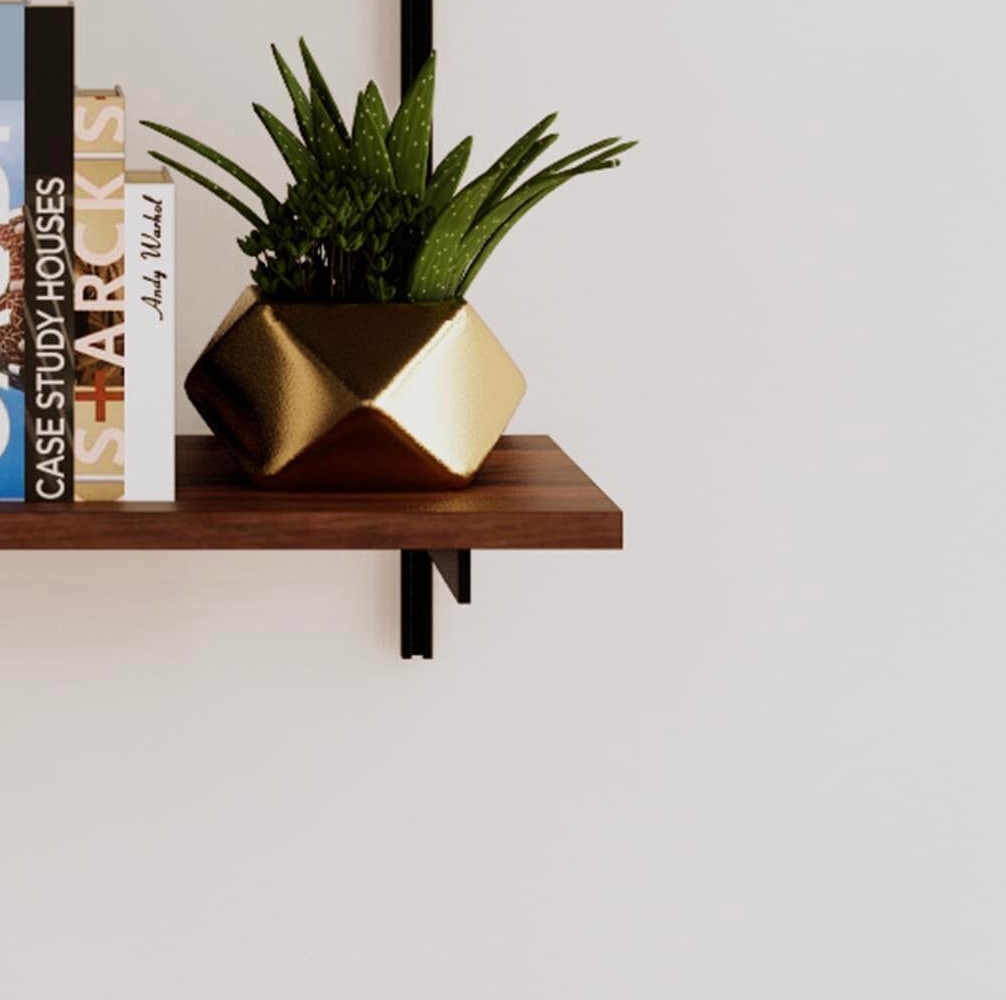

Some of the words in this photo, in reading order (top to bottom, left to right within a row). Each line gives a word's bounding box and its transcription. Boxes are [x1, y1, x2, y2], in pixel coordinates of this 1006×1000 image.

[36, 177, 65, 301] HOUSES
[140, 194, 163, 260] Warhol
[141, 269, 167, 321] Andy
[36, 310, 65, 410] STUDY
[36, 417, 65, 500] CASE
